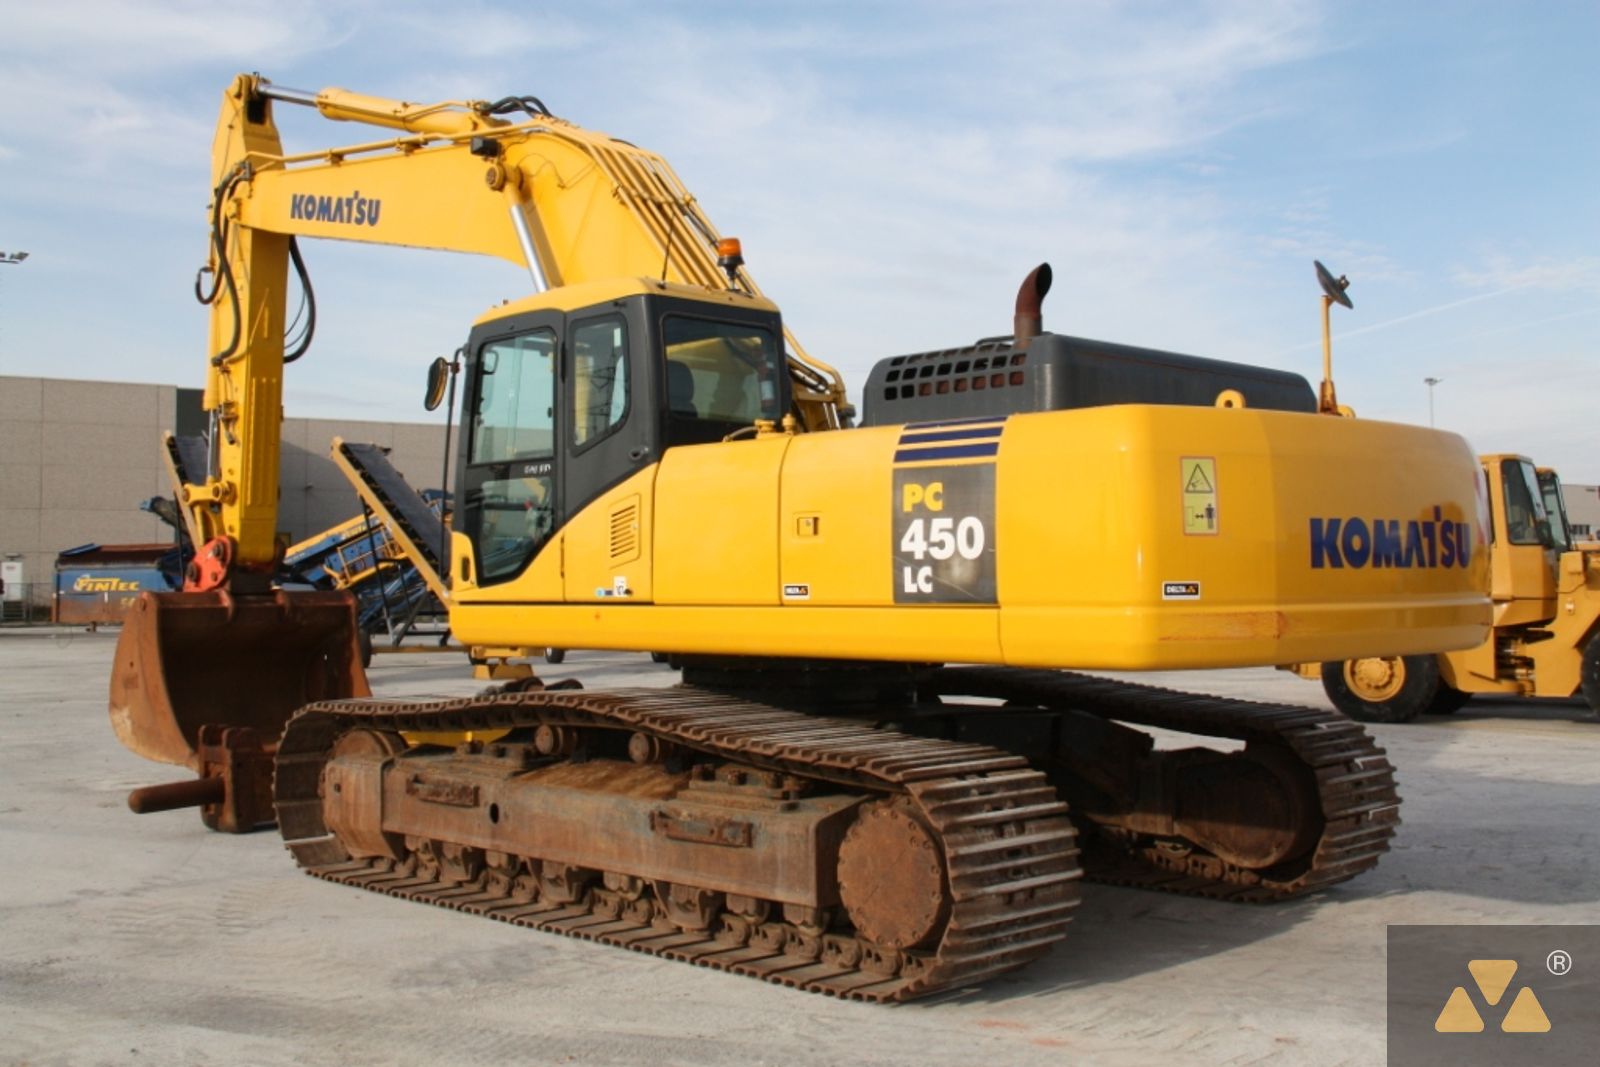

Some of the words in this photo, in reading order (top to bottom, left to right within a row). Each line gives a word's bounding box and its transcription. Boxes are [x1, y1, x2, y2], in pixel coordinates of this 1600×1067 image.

[290, 190, 381, 227] KOMATSU
[902, 482, 944, 512] PC
[900, 516, 985, 560] 450
[1310, 505, 1471, 569] KOMATSU
[903, 566, 933, 593] LC
